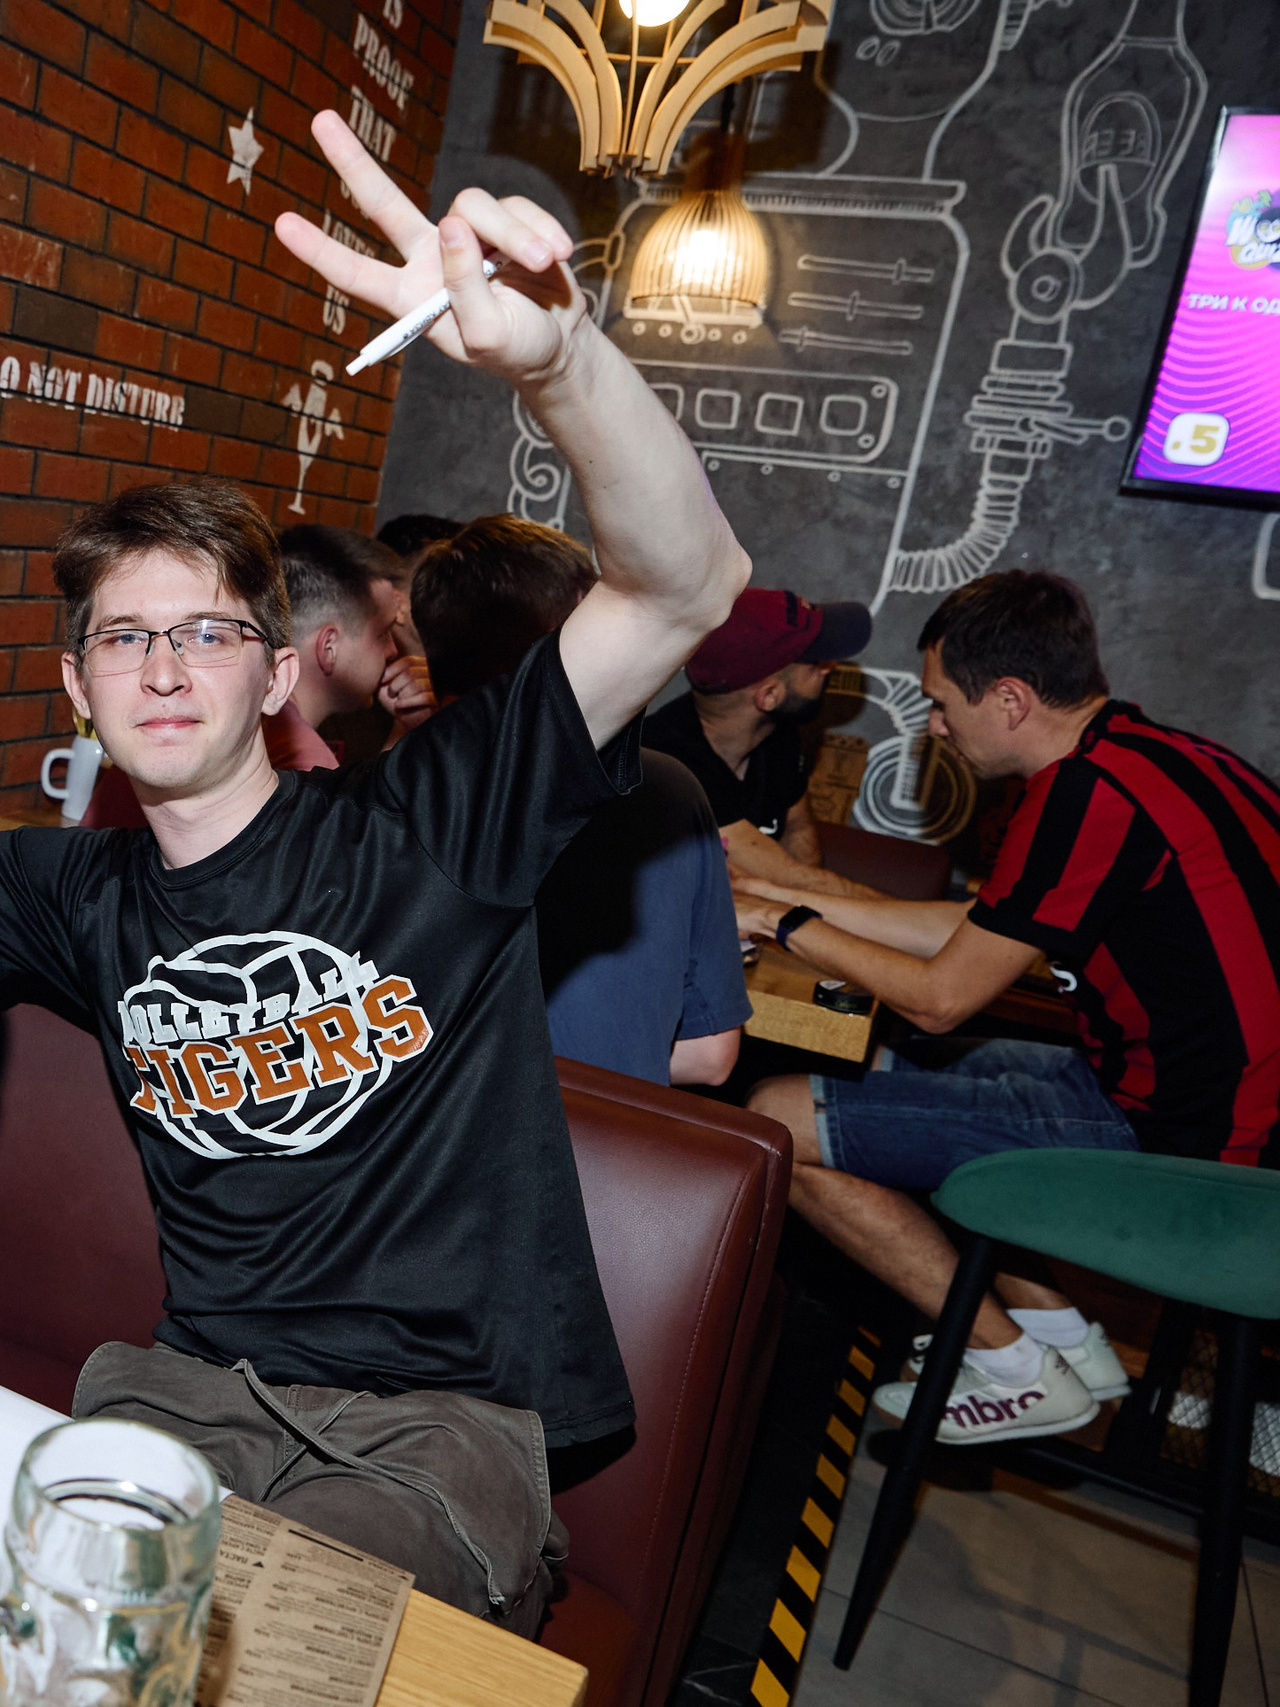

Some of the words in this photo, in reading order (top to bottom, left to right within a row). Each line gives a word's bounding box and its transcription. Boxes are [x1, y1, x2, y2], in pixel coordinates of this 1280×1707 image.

[352, 12, 414, 111] PROOF
[348, 84, 396, 163] THAT
[1187, 292, 1230, 310] ТРИ
[1230, 295, 1248, 311] К
[26, 361, 82, 410] NOT
[84, 373, 186, 432] DISTURB
[122, 974, 434, 1118] TIGERS
[942, 1391, 1045, 1428] mbro
